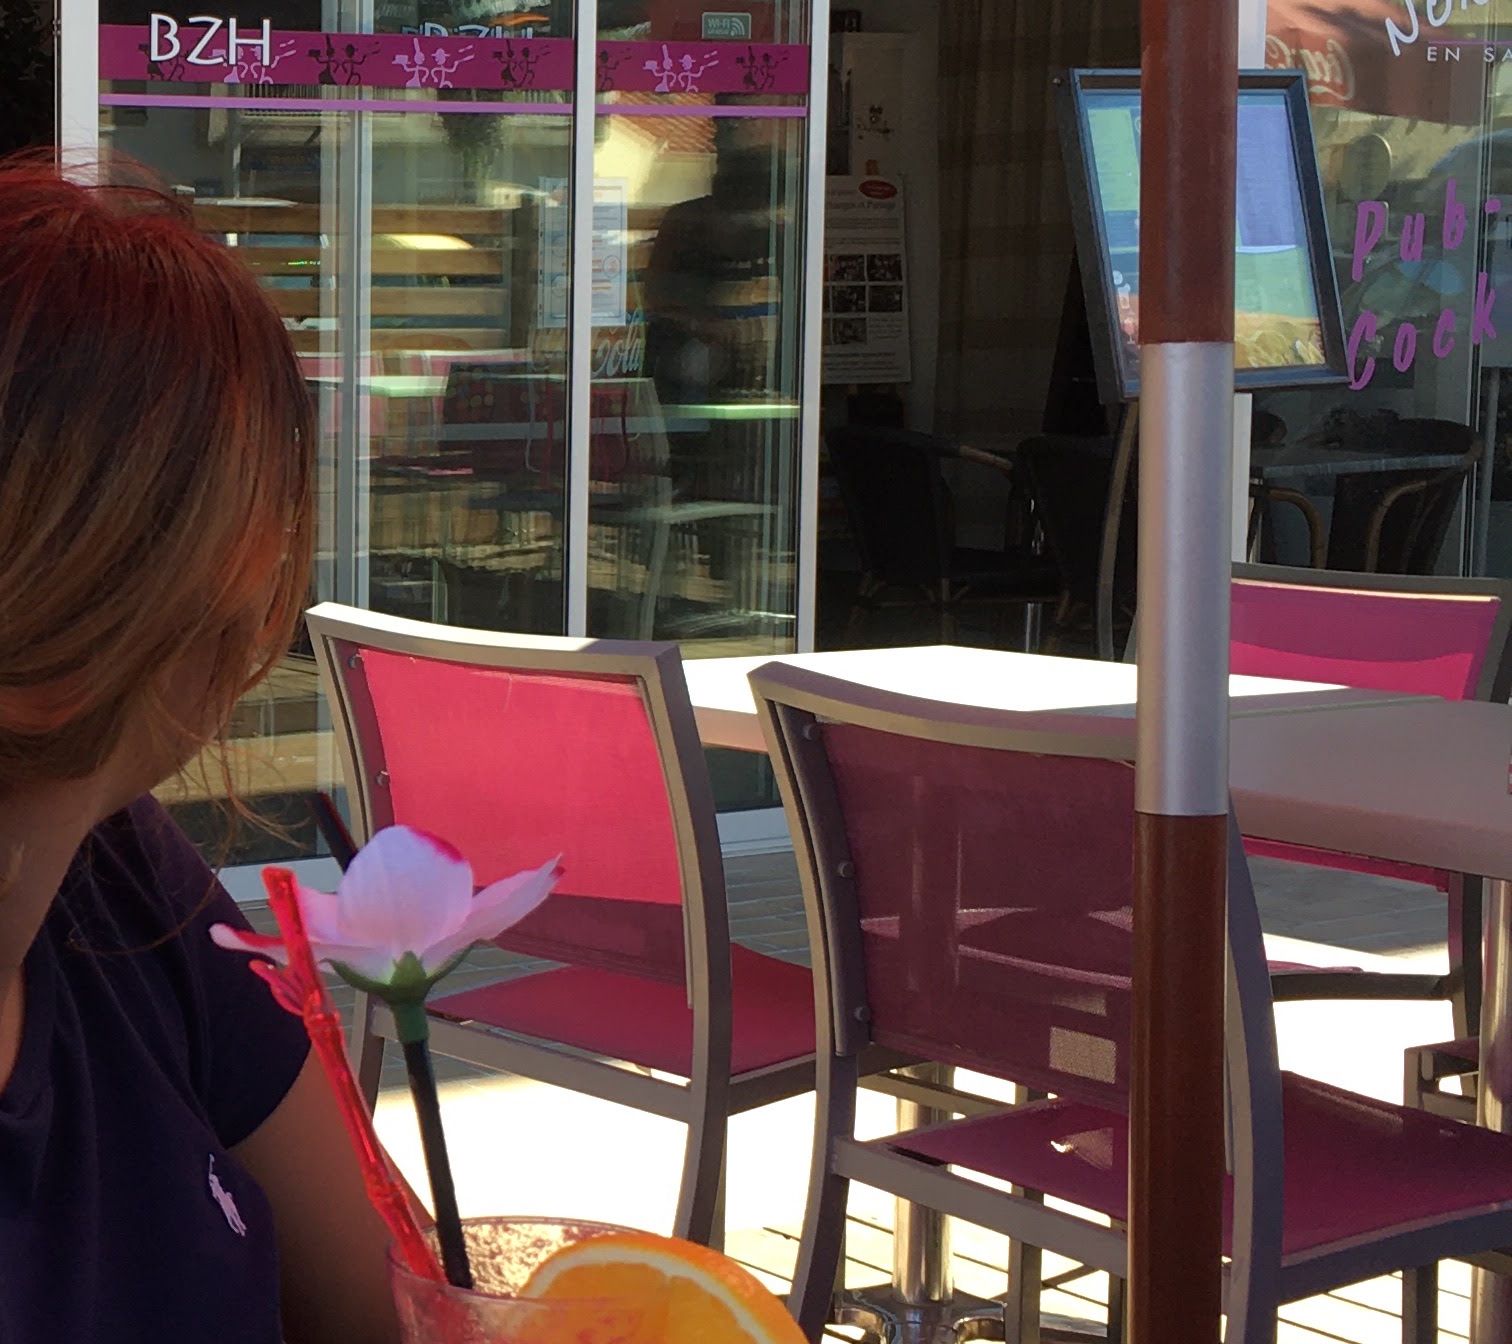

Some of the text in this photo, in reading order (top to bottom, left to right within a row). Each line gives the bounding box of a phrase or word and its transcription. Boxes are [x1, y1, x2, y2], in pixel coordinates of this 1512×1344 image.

[148, 13, 272, 67] BZH
[1426, 46, 1461, 63] EN
[1348, 271, 1497, 391] Cock
